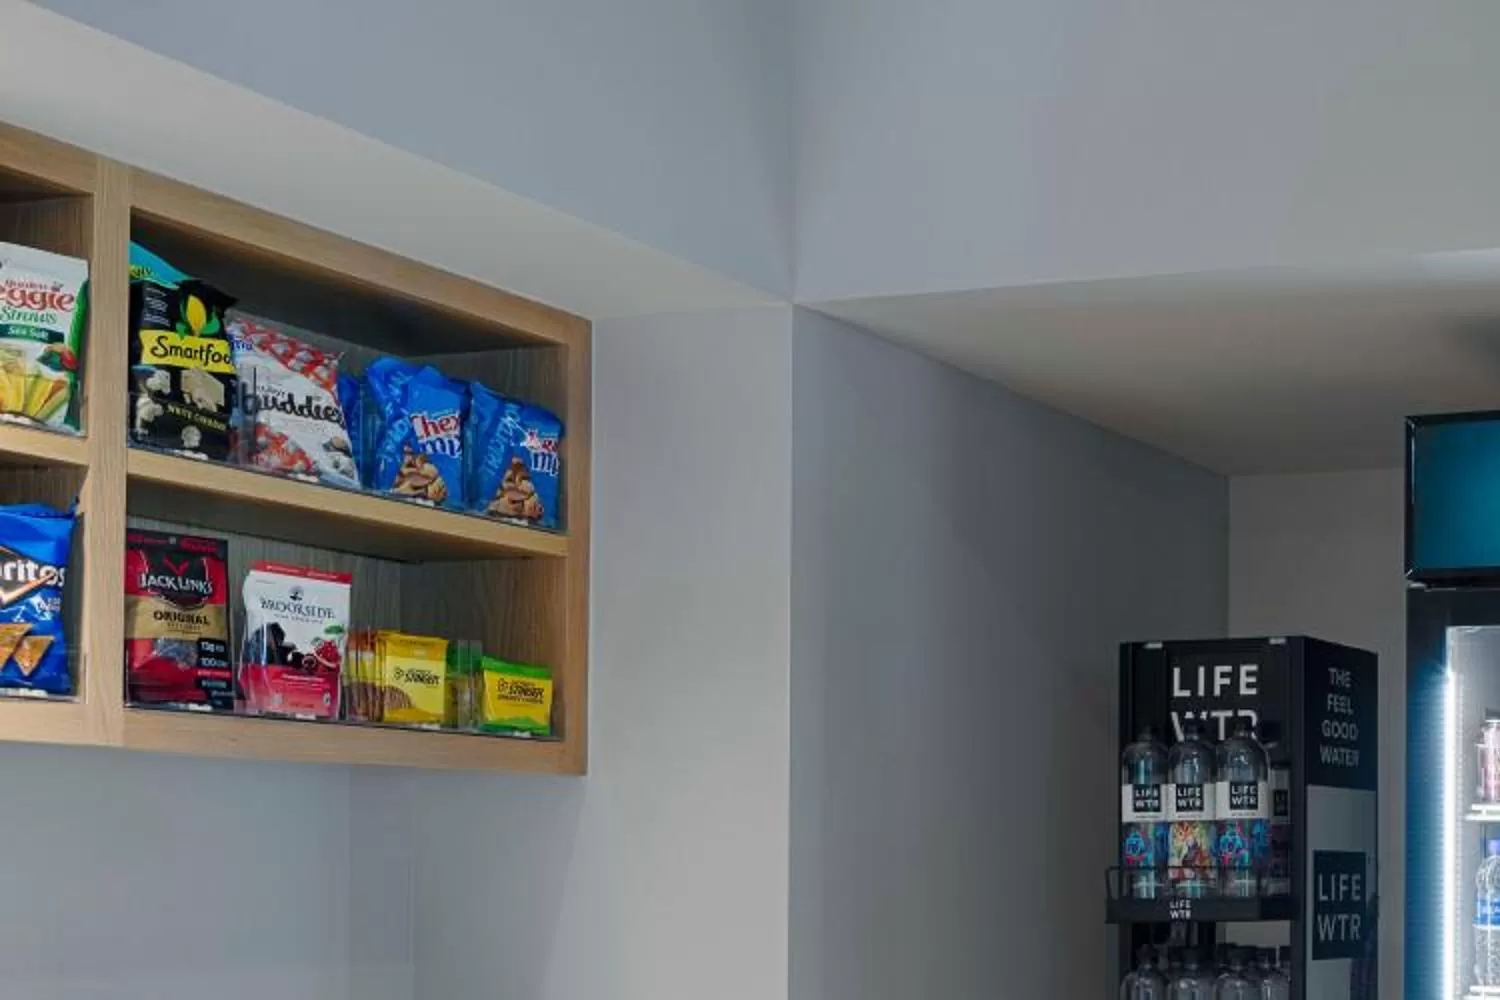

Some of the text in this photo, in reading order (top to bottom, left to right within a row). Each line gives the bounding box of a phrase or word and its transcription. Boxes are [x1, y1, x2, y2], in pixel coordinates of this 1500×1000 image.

[151, 335, 231, 366] Smartfoo
[0, 559, 65, 587] ritos
[1173, 664, 1258, 697] LIFE
[1328, 667, 1352, 688] THE
[1327, 693, 1354, 715] FEEL
[1321, 719, 1360, 740] GOOD
[1319, 744, 1360, 767] WATER
[1318, 873, 1361, 902] LIFE
[1317, 913, 1361, 942] WTR
